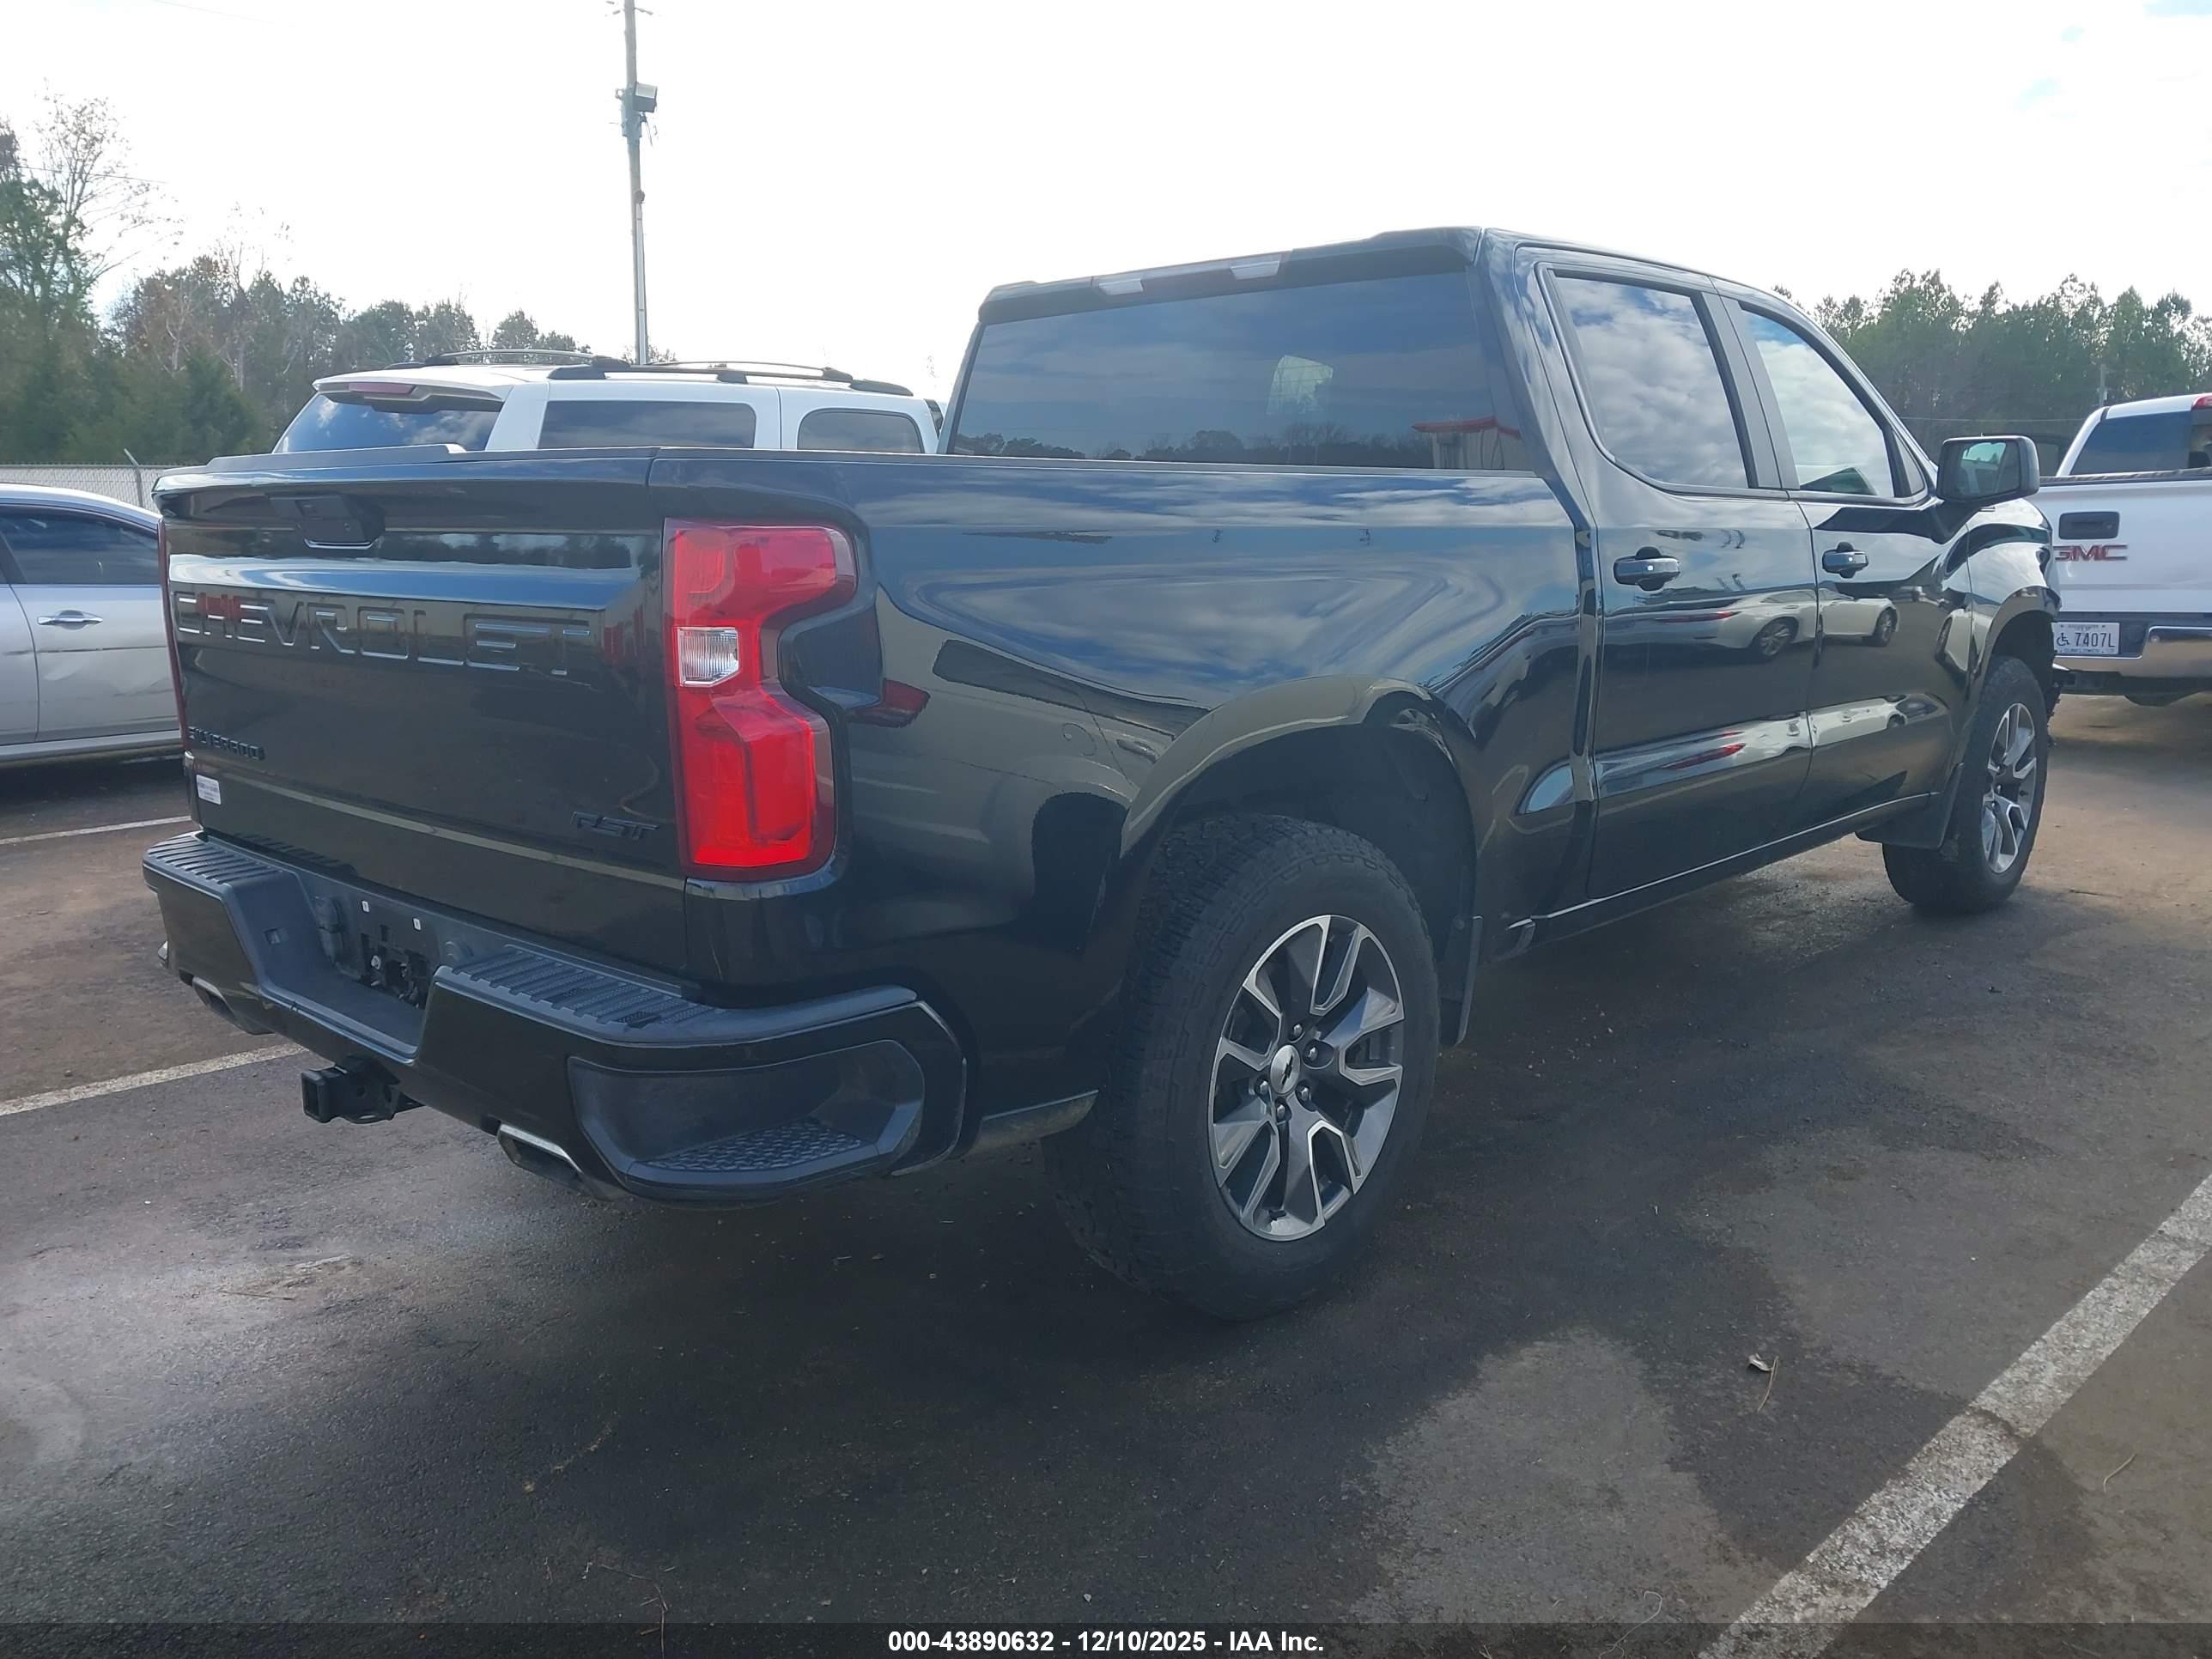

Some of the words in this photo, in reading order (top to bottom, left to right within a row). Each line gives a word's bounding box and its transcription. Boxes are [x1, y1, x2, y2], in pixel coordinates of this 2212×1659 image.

[2052, 544, 2128, 562] GMC
[173, 591, 590, 676] CHEVROLET
[2074, 632, 2116, 647] 7407L
[570, 811, 659, 841] RST
